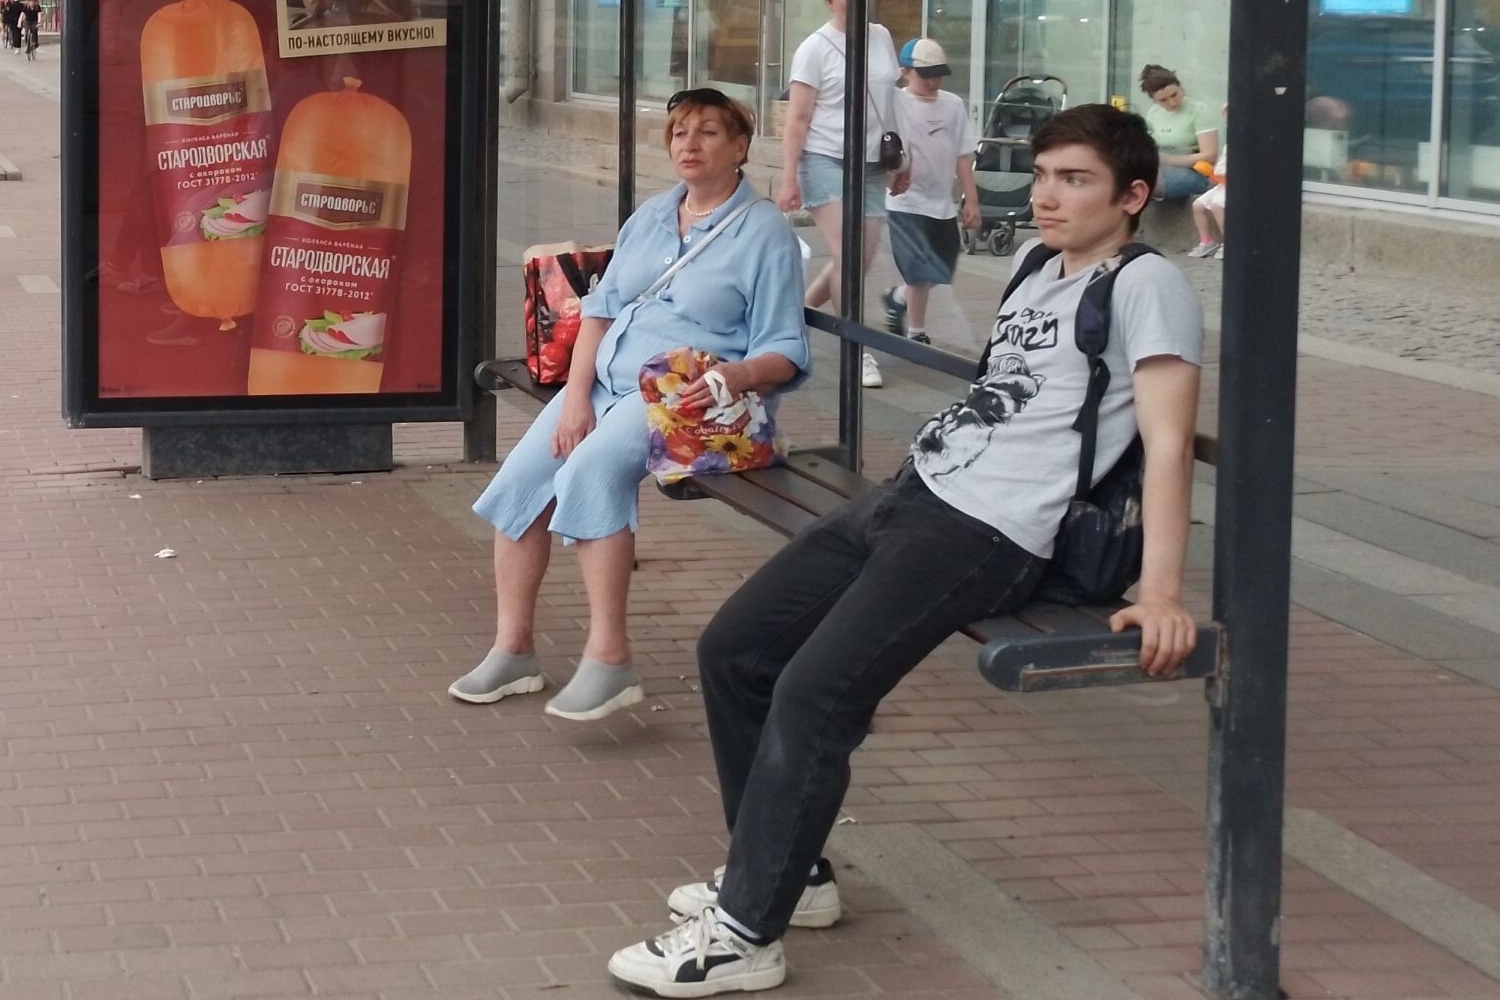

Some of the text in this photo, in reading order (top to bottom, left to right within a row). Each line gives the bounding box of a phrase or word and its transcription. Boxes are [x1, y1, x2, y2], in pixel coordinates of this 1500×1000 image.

[288, 26, 435, 49] ПО-НАСТОЯЩЕМУ ВКУСНО!
[172, 91, 242, 111] СТАРОДВОРЬЕ
[158, 139, 267, 170] СТАРОДВОРСКАЯ
[177, 179, 203, 190] ГОСТ
[300, 193, 377, 214] СТАРОДВОРЬЕ
[271, 245, 391, 279] СТАРОДВОРСКАЯ
[285, 282, 313, 294] ГОСТ
